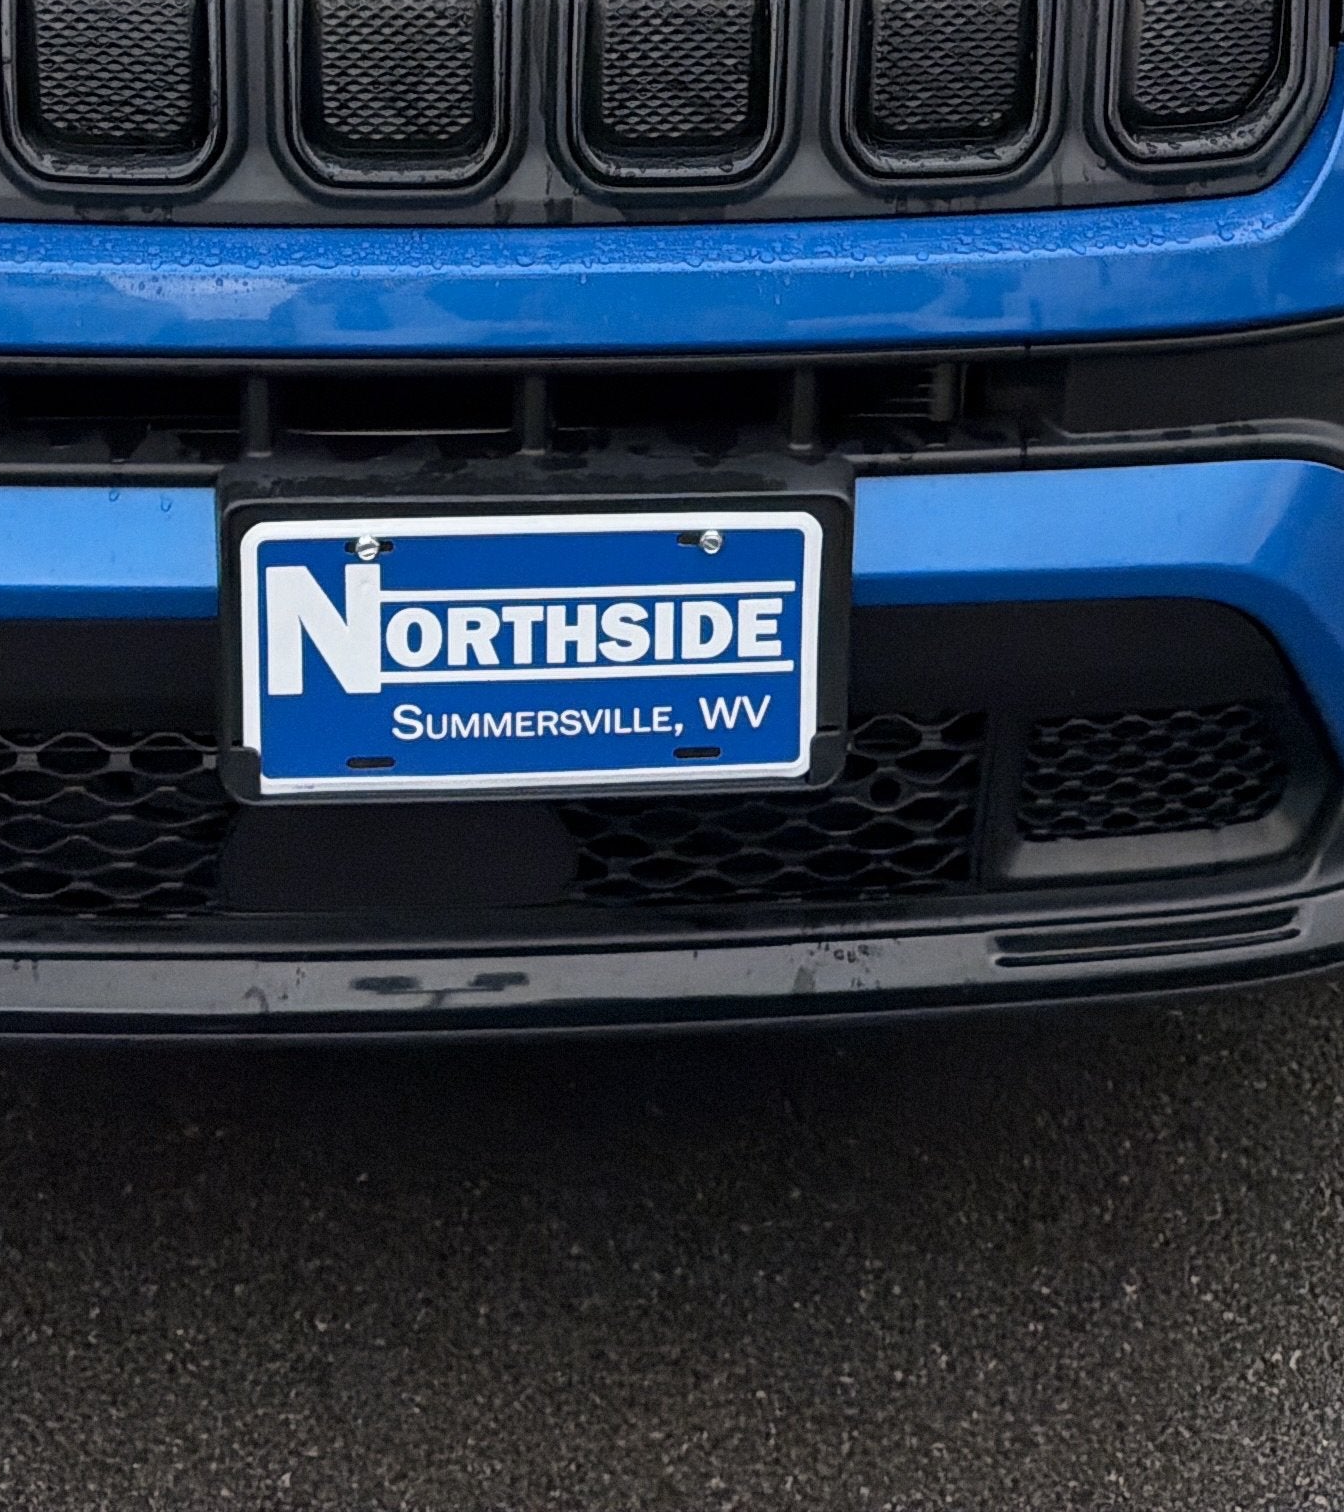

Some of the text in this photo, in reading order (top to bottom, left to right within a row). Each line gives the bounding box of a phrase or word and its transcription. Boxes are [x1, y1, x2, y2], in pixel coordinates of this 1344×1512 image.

[265, 563, 784, 695] NORTHSIDE
[391, 694, 771, 740] SUMMERSVILLE, WV
